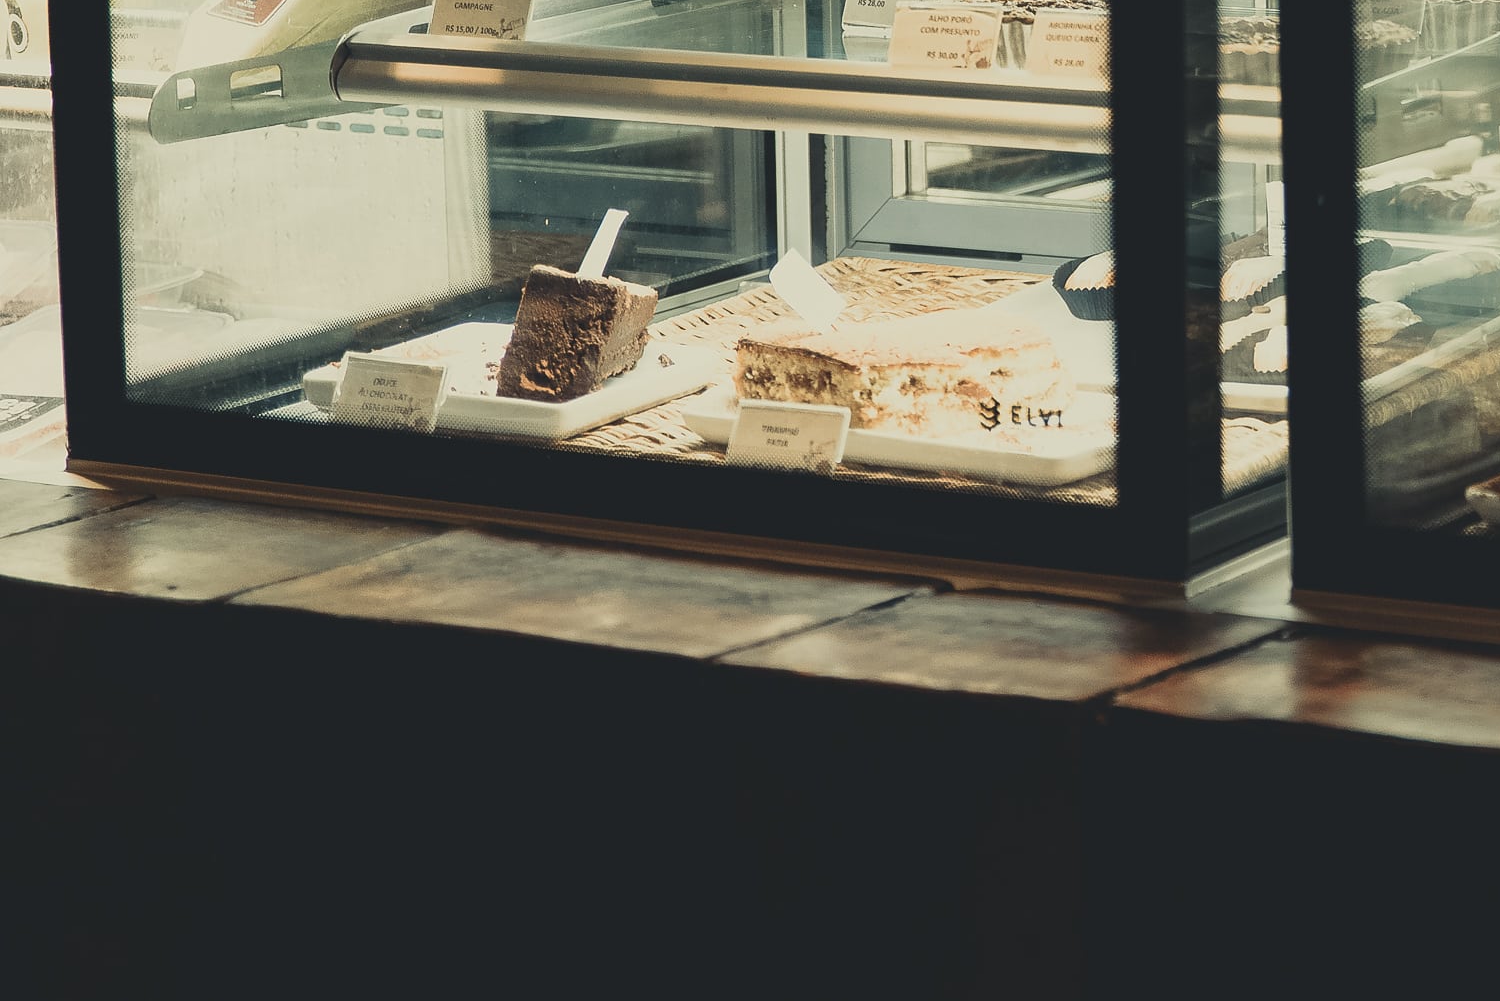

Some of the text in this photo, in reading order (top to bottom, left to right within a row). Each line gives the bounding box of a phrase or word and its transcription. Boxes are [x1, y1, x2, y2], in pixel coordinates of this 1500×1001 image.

[454, 2, 494, 11] CAMPAGNE
[867, 0, 885, 7] 28,00
[445, 25, 454, 33] R$
[456, 25, 474, 34] 15,00
[920, 26, 980, 36] COM PRESUNTO
